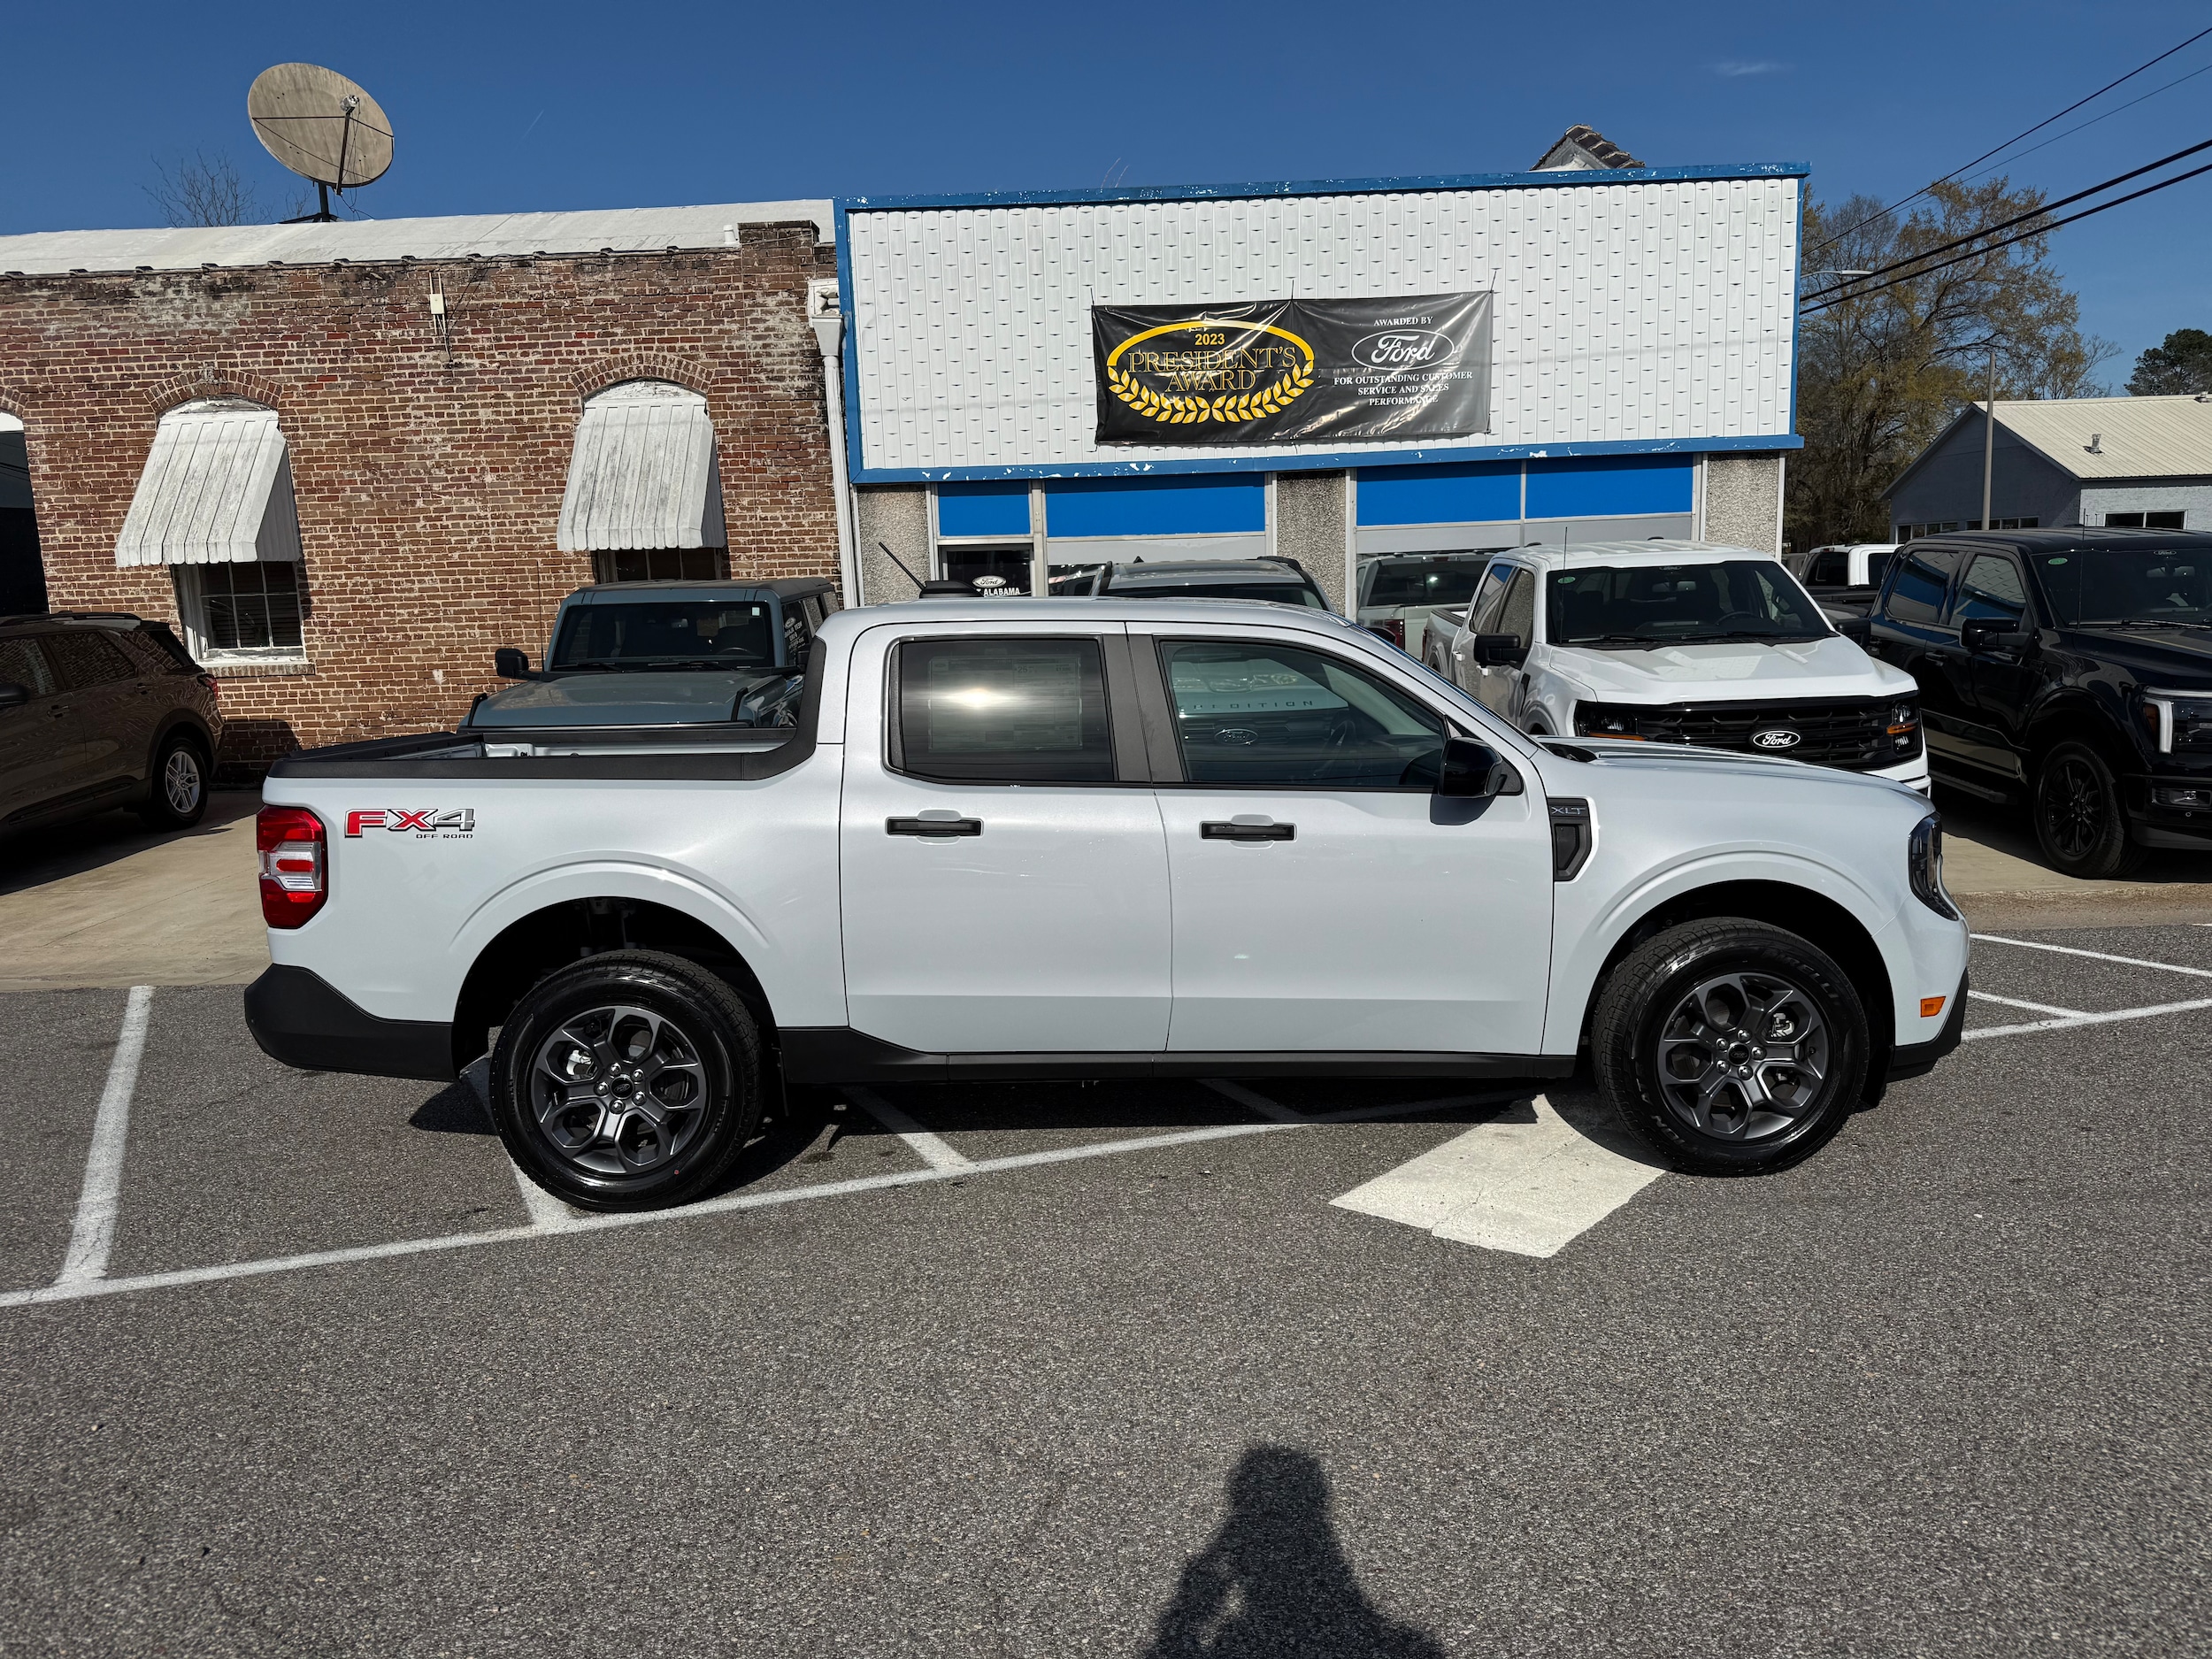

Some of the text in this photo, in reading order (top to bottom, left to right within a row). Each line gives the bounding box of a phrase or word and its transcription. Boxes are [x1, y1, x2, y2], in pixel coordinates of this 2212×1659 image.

[1374, 316, 1433, 326] AWARDED BY
[1194, 333, 1225, 346] 2023
[1371, 334, 1435, 364] Ford
[1127, 347, 1296, 373] PRESIDENT'S
[1164, 369, 1256, 393] AWARD
[1333, 371, 1473, 386] FOR OUTSTANDING CUSTOMER
[1357, 383, 1449, 396] SERVICE AND SALES
[1369, 394, 1439, 406] PERFORMANCE
[983, 588, 1021, 596] ALABAMA
[1762, 733, 1792, 745] Ford
[1550, 806, 1586, 815] XLT
[344, 808, 476, 839] FX4
